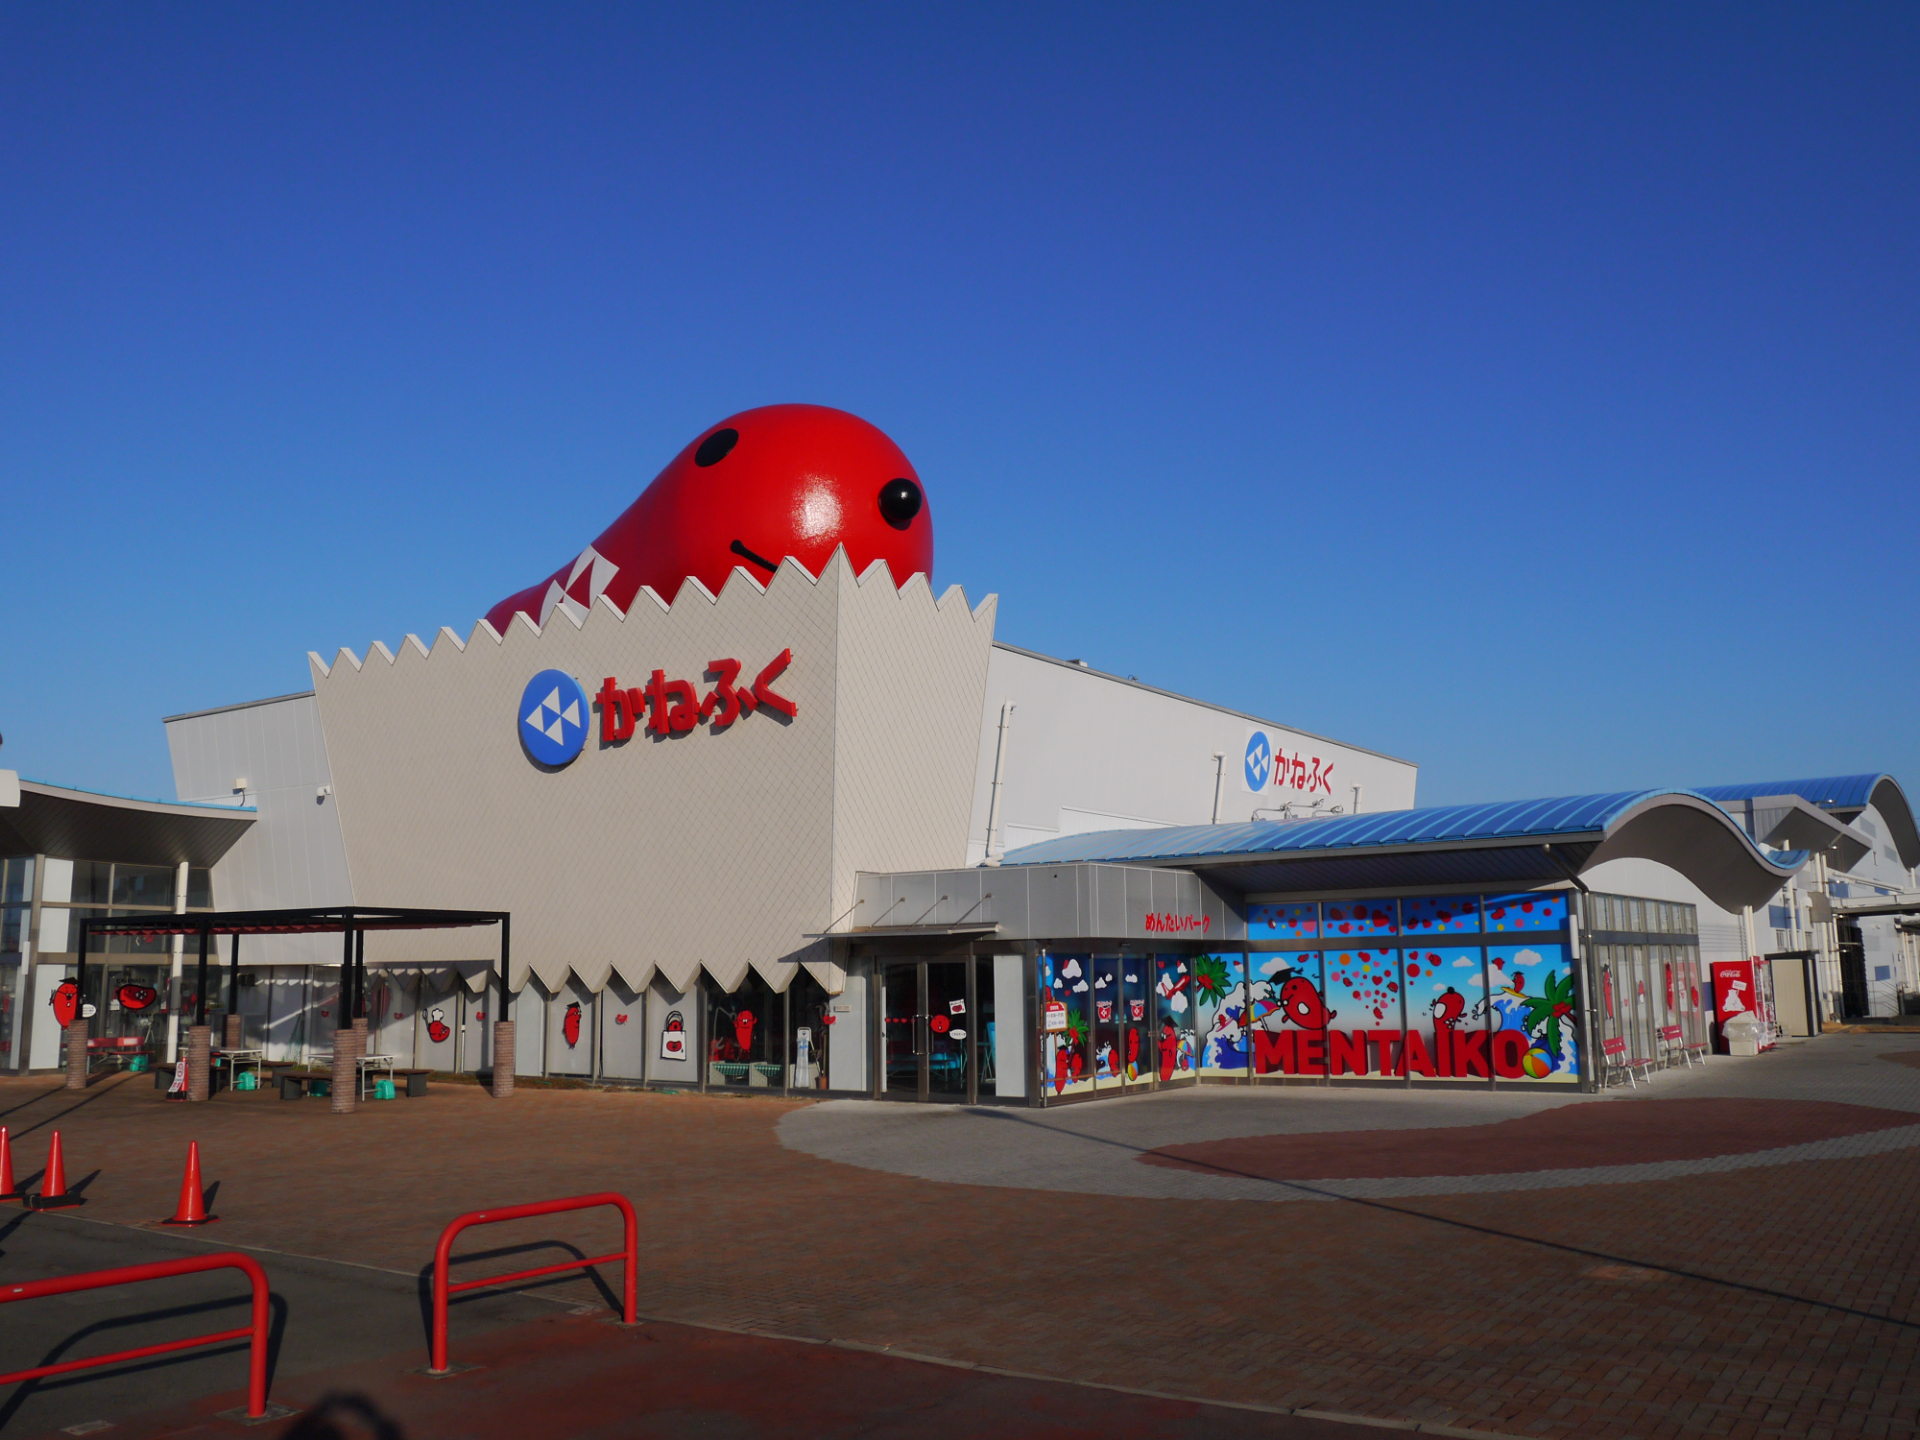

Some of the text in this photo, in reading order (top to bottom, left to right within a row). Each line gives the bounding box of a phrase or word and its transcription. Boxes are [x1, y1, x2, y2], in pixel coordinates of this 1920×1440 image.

[595, 647, 798, 743] かねふく
[1274, 748, 1334, 795] かねふく
[1145, 912, 1211, 934] めんたいパーク
[1255, 1029, 1530, 1079] MENTAIKO
